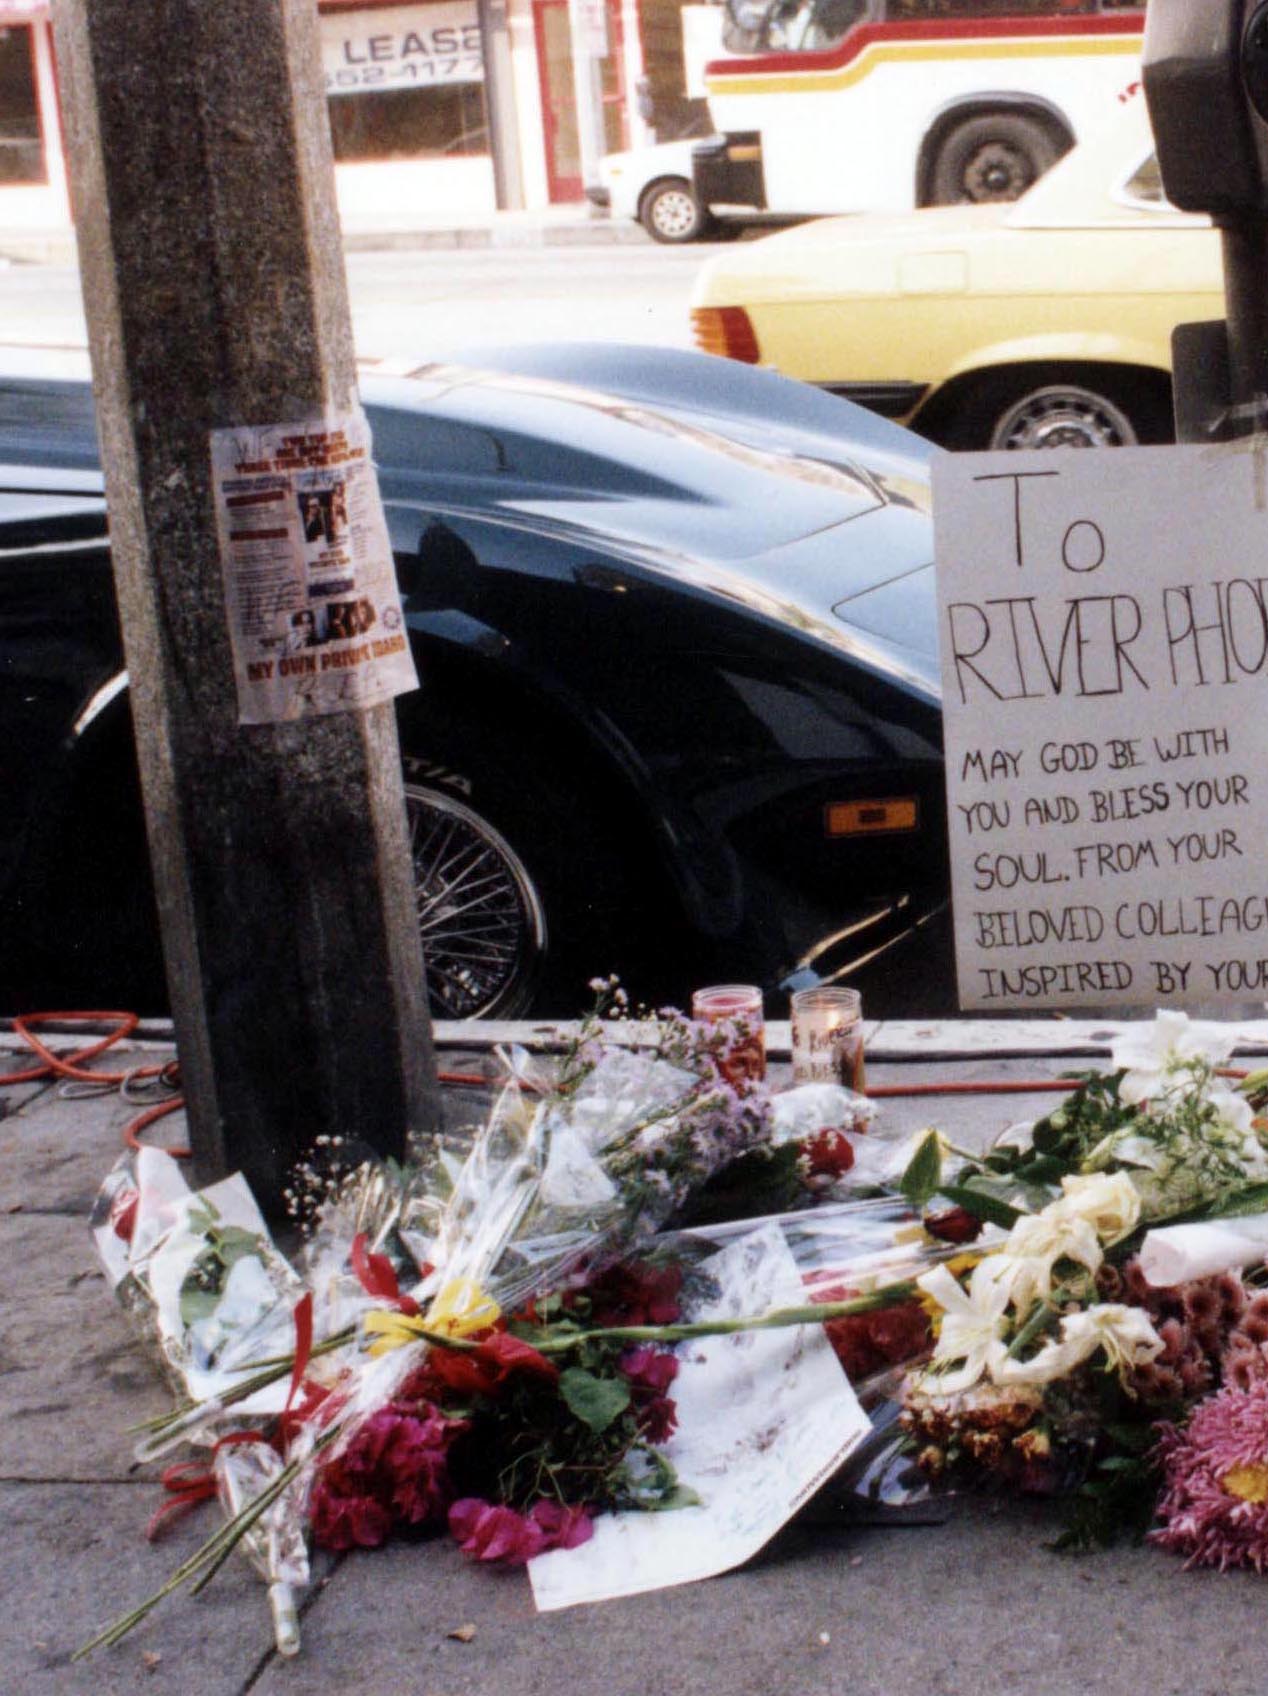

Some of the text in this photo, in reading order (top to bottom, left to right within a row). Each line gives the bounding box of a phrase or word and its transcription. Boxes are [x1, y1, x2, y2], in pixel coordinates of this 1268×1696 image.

[343, 25, 480, 65] LEASE
[973, 471, 1105, 573] To
[948, 594, 1150, 704] RIVER
[961, 728, 1230, 782] MAY GOD BE WITH
[958, 775, 1250, 834] YOU AND BLESS YOUR
[973, 829, 1244, 891] SOUL. FROM YOUR
[974, 905, 1104, 949] BELOVED
[978, 960, 1133, 999] INSPIRED
[1150, 960, 1192, 995] BY
